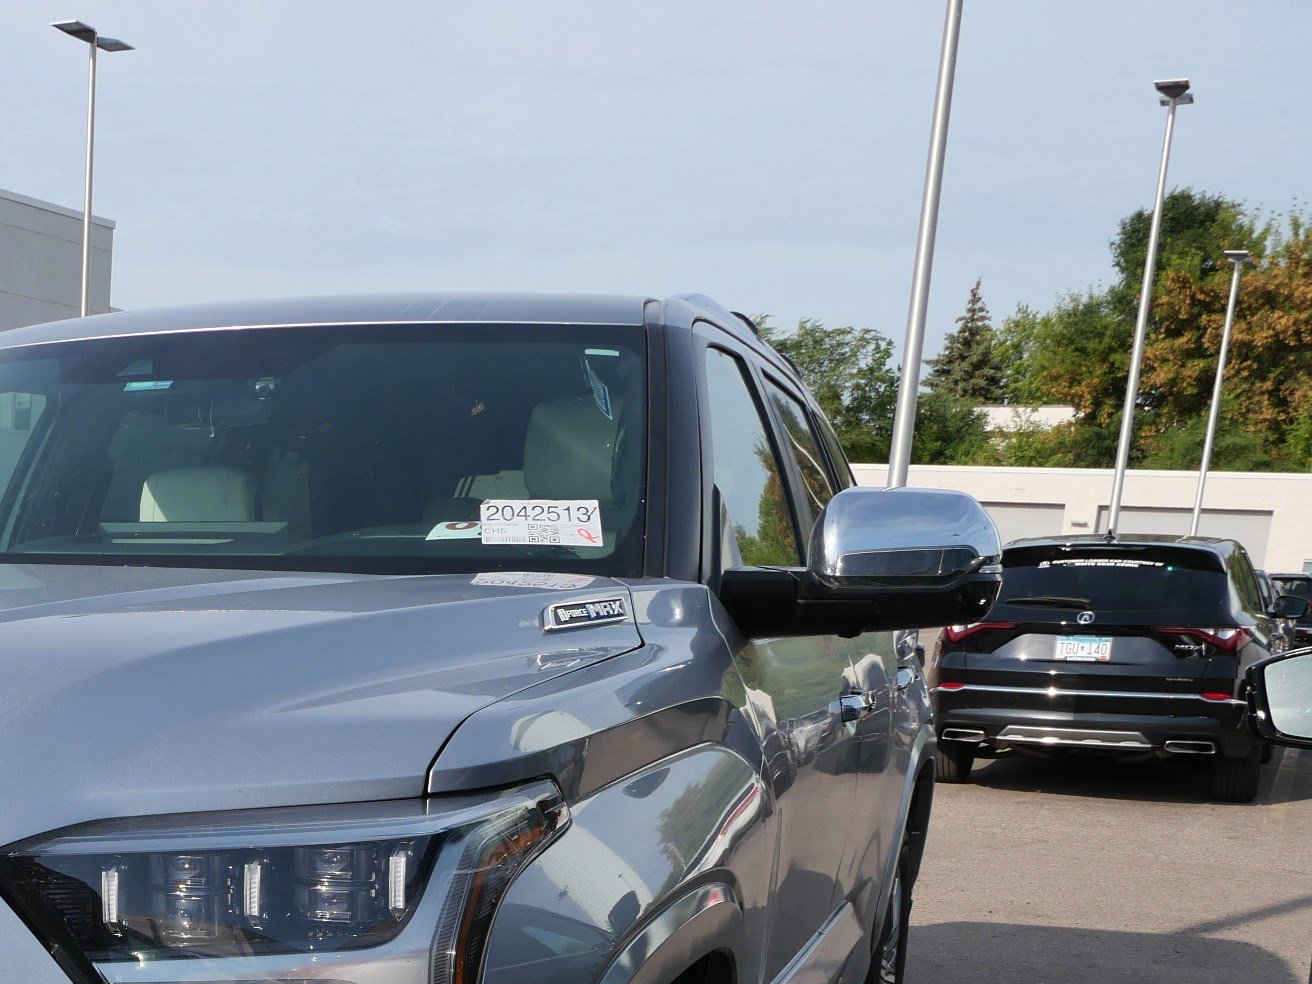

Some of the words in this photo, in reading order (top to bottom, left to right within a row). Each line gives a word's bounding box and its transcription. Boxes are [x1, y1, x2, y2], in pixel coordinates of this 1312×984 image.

[486, 505, 591, 523] 2042513
[586, 601, 624, 620] MAX
[1060, 642, 1079, 655] TGU
[1086, 642, 1108, 656] 140
